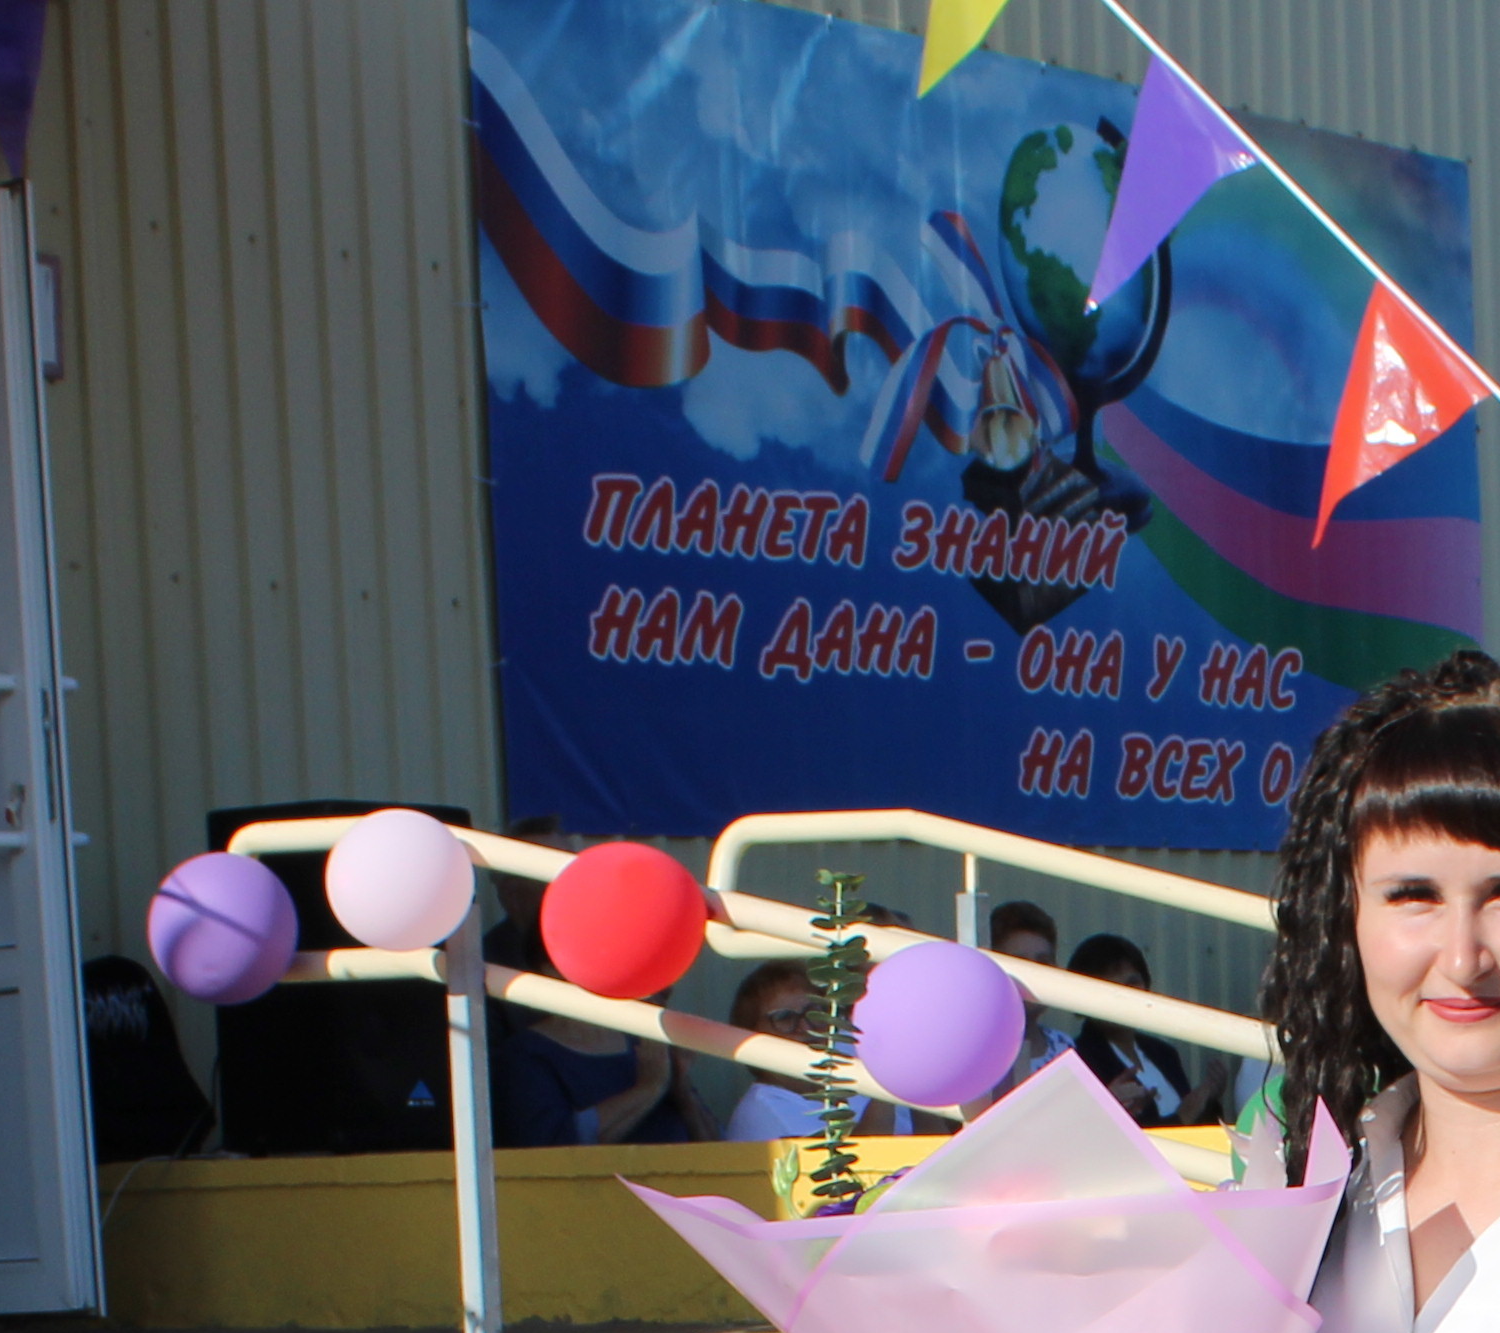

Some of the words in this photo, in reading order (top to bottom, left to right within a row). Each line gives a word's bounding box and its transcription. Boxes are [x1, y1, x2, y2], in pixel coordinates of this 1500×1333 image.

[584, 474, 868, 567] ПЛАНЕТА
[894, 502, 1125, 589] ЗНАНИЙ
[589, 586, 742, 669] НАМ
[761, 599, 936, 681] ДАНА
[1019, 625, 1123, 700] ОНА
[1147, 636, 1184, 701] У
[1200, 641, 1301, 711] НАС
[1020, 728, 1092, 798] НА
[1117, 733, 1245, 804] ВСЕХ
[1261, 740, 1304, 810] О
